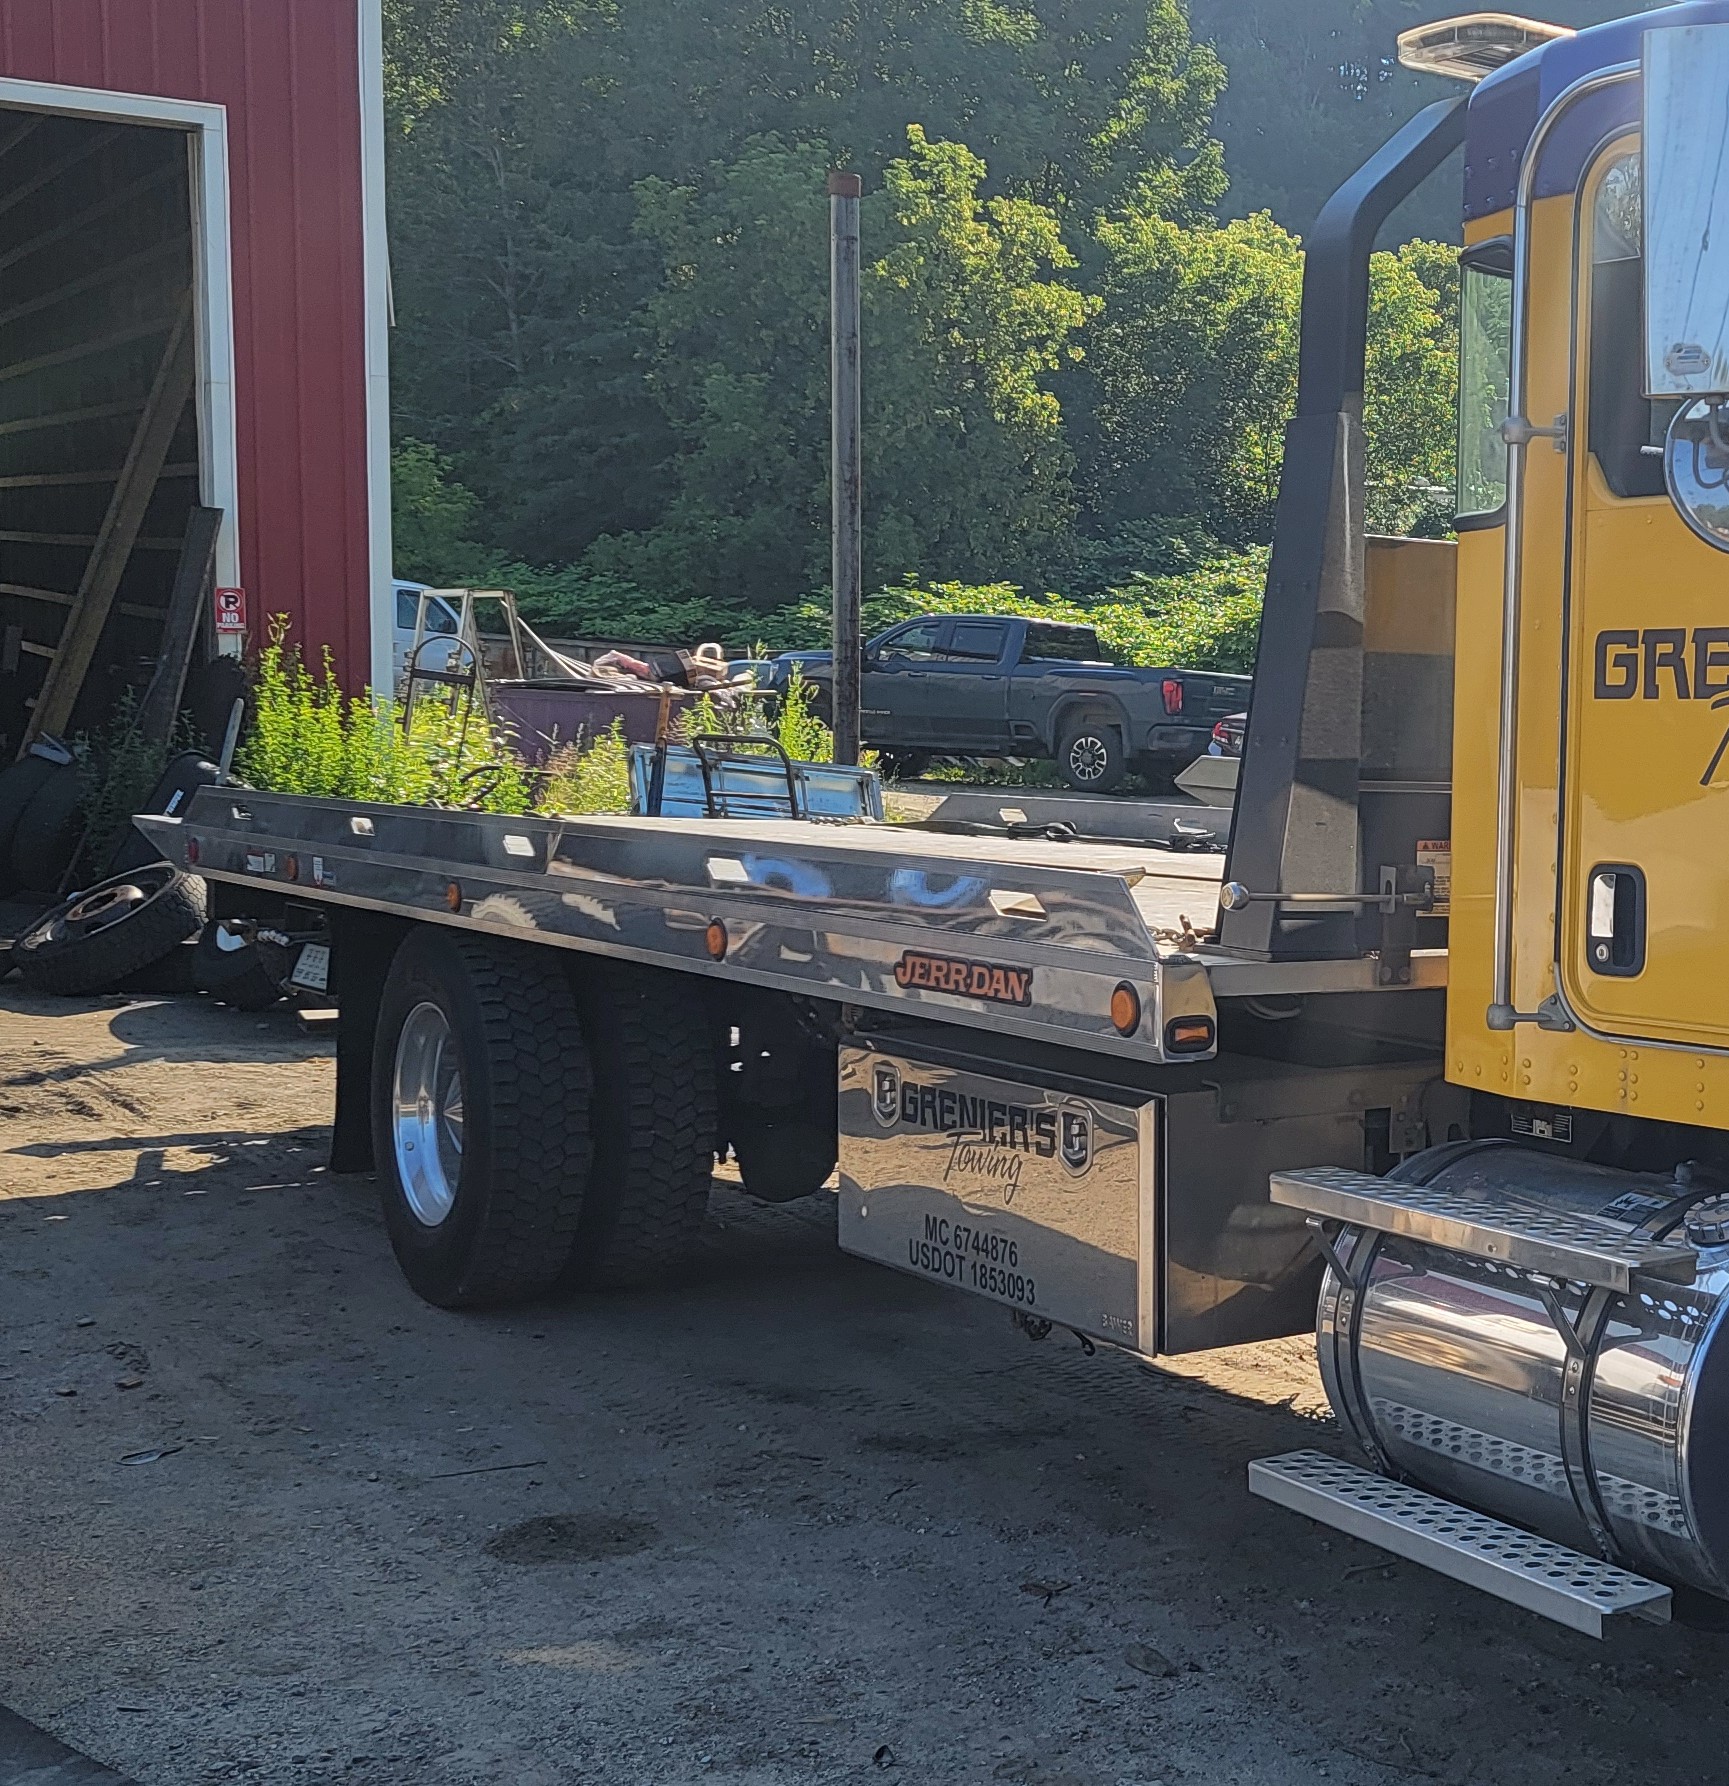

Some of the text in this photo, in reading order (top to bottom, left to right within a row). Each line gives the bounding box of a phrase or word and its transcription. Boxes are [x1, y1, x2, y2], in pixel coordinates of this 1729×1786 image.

[222, 612, 239, 622] NO
[901, 1080, 1058, 1159] GRENIER'S
[942, 1129, 1024, 1205] Towing
[909, 1237, 1036, 1306] USDOT 1853093
[924, 1213, 1018, 1268] MC 6744876
